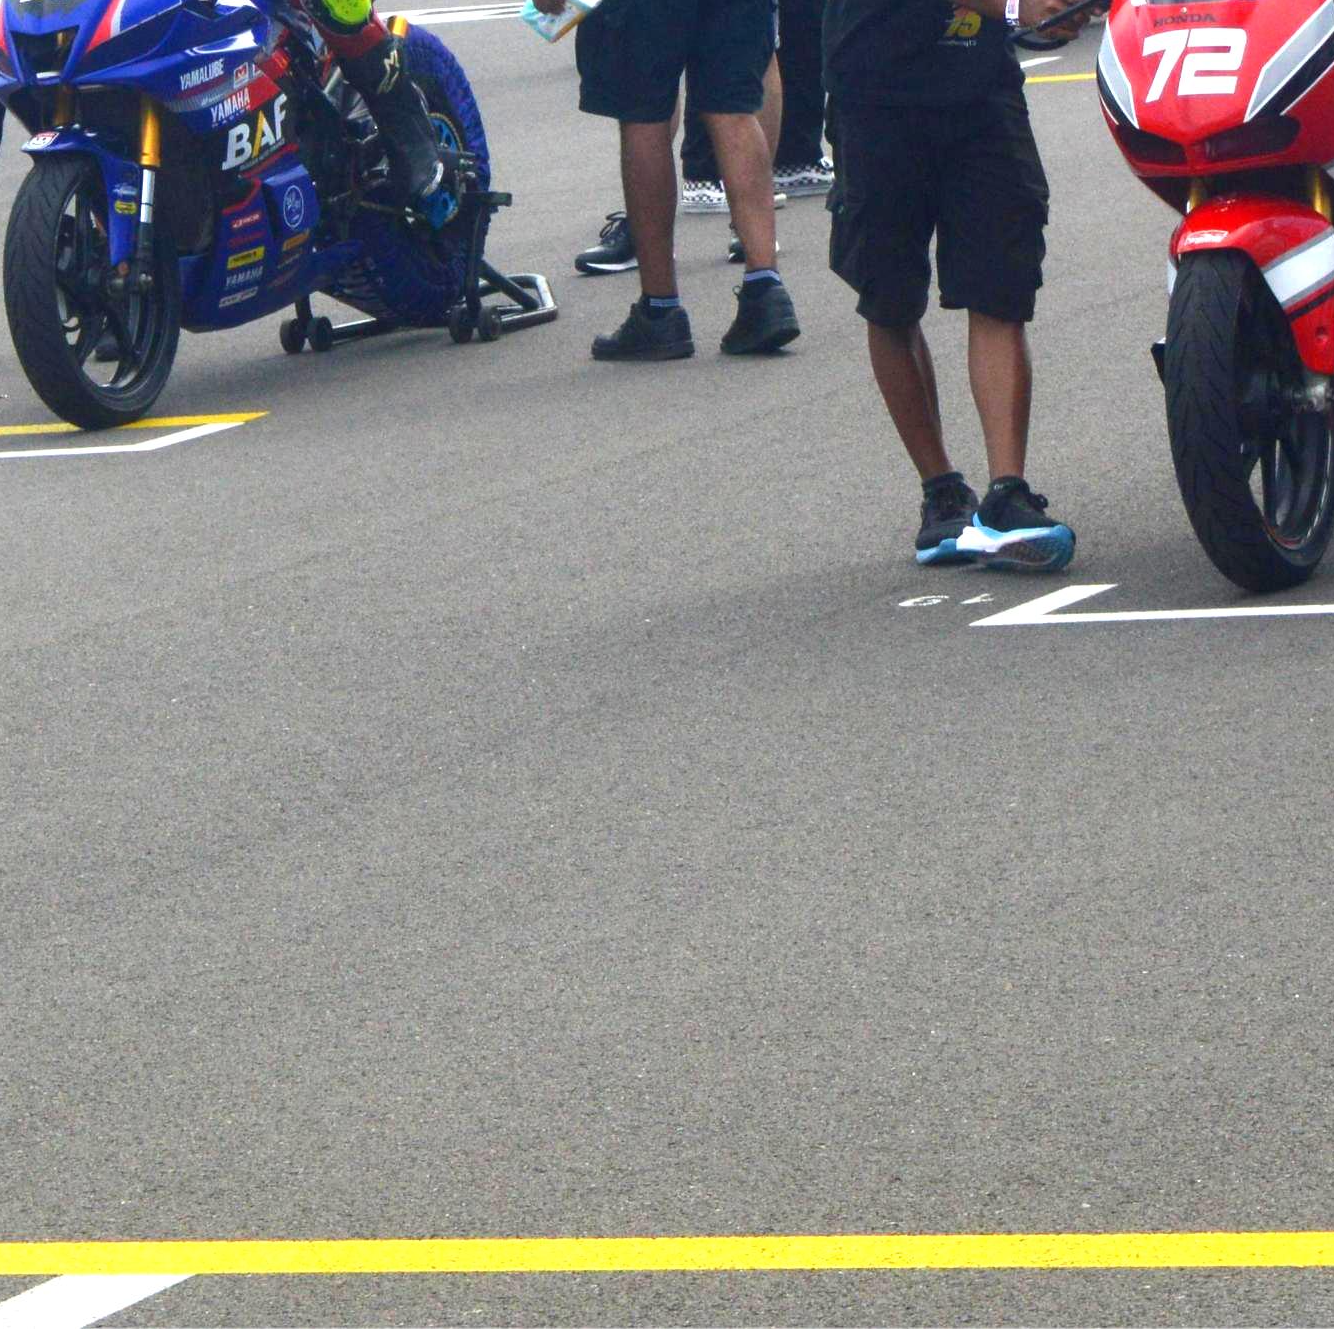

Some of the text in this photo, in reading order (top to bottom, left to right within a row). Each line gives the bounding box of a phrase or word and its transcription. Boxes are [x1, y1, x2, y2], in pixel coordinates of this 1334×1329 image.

[179, 58, 225, 91] YAMALUBE
[1142, 27, 1248, 104] 72
[211, 87, 251, 123] YAMAHA
[222, 93, 288, 171] BAF
